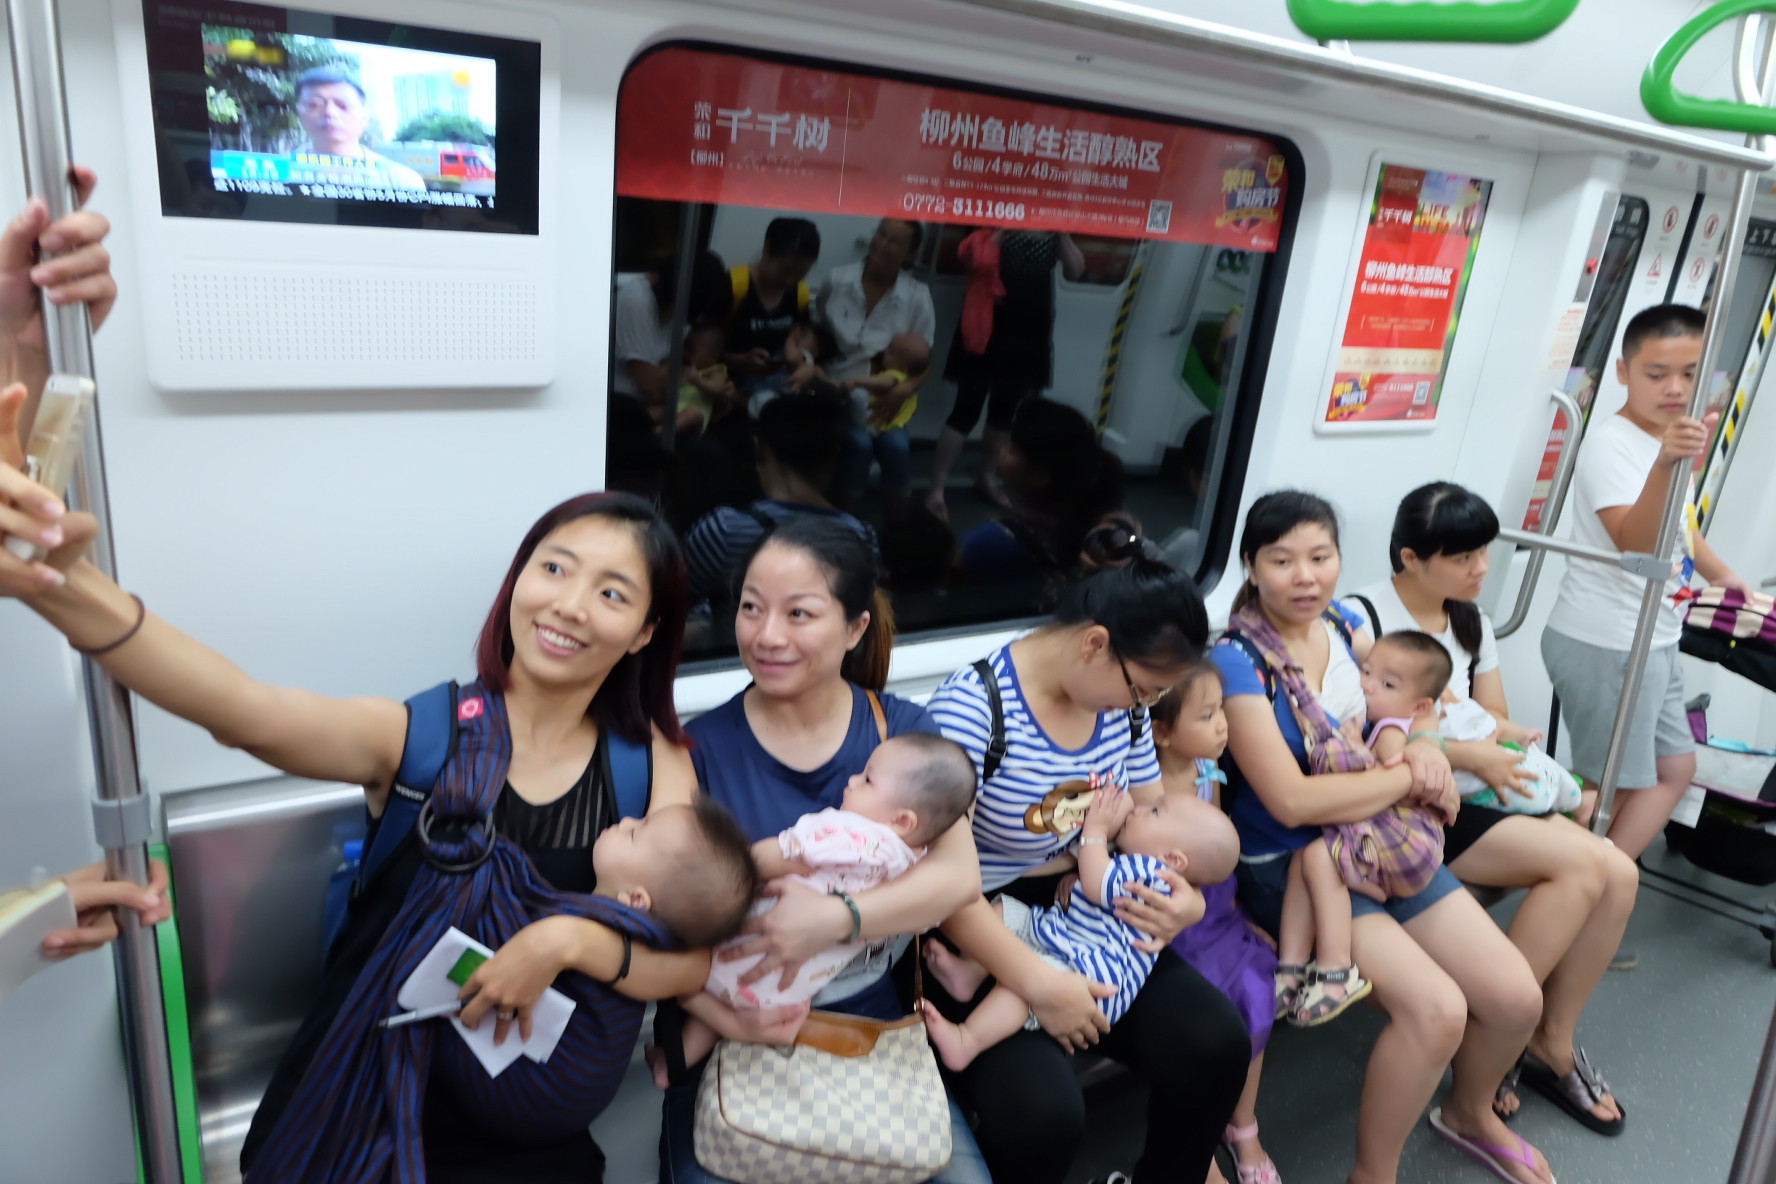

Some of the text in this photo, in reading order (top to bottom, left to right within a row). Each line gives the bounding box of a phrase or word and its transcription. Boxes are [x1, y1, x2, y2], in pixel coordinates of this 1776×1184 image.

[716, 107, 831, 152] 千千树
[920, 107, 1163, 173] 柳州鱼峰生活醇熟区
[952, 197, 1026, 221] 5111666
